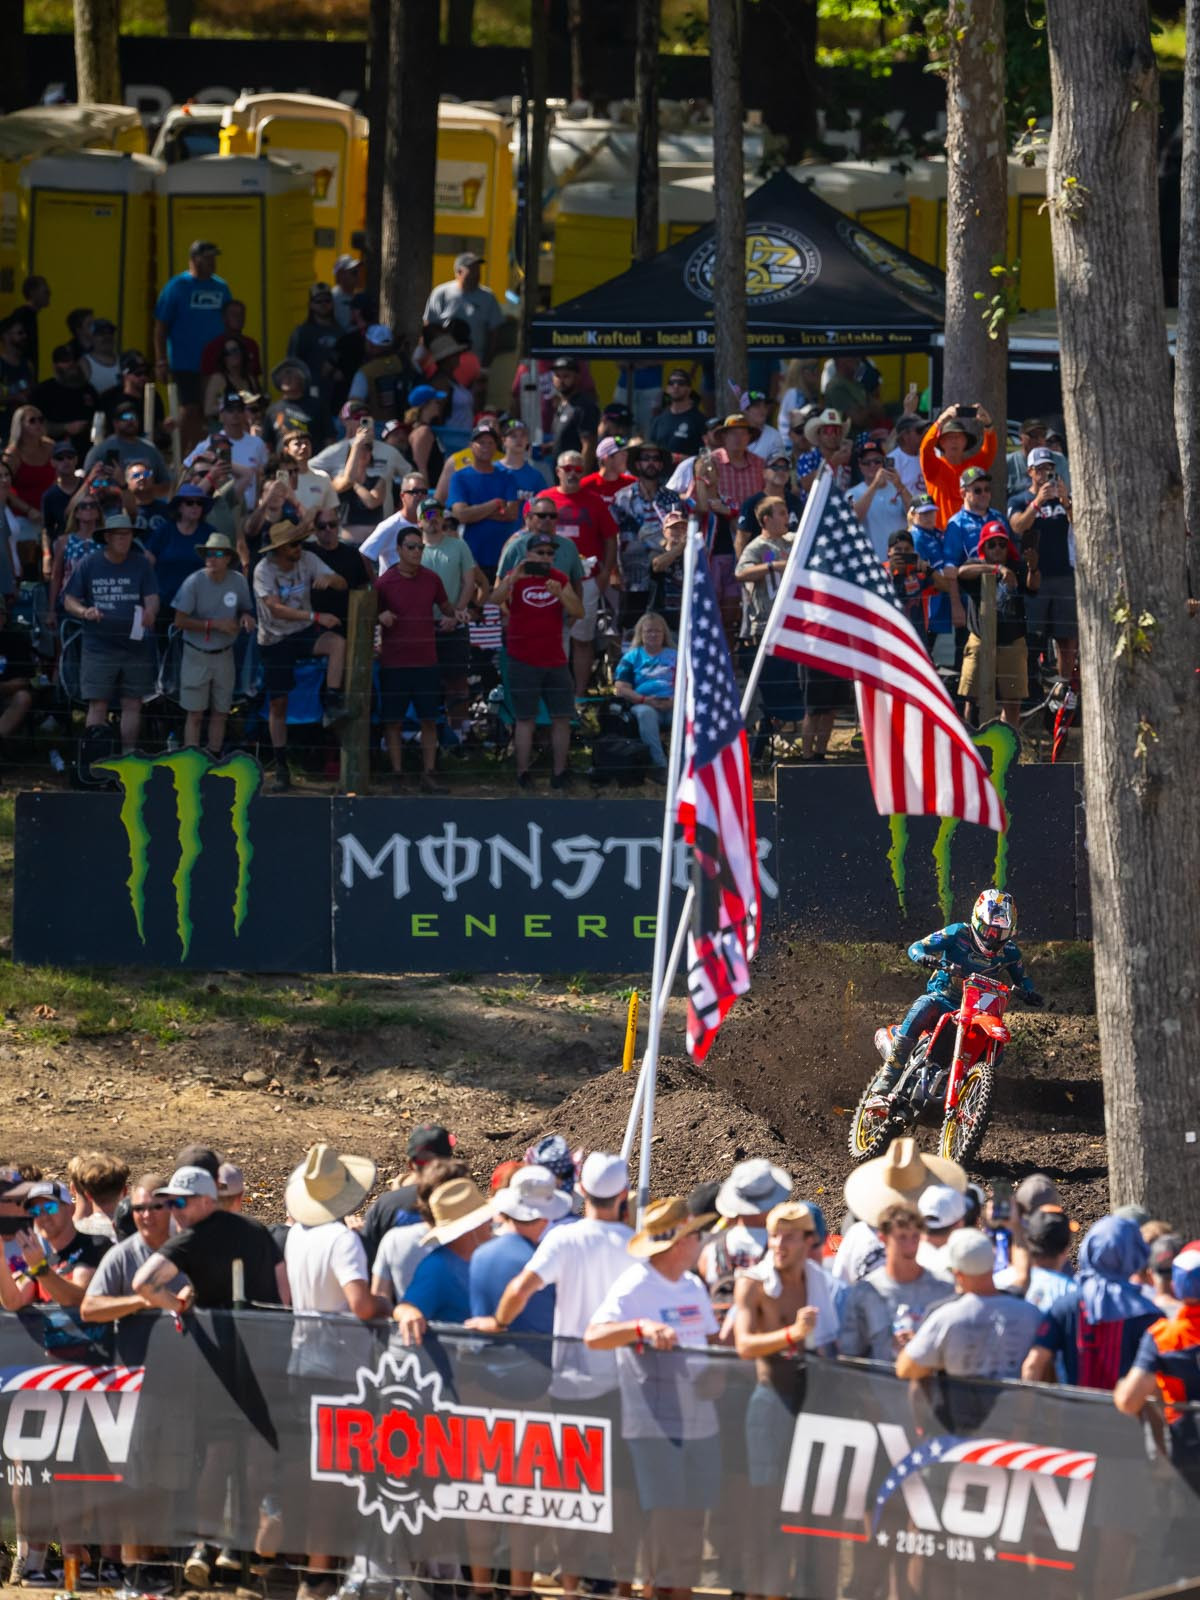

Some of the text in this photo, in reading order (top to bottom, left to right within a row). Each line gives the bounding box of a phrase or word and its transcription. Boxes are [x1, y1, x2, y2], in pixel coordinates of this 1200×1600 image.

[552, 331, 640, 345] handKrafted
[656, 330, 692, 345] local
[697, 330, 717, 345] Bo
[92, 577, 131, 586] HOLD ON
[411, 914, 657, 939] ENERG
[973, 993, 997, 1011] 1
[0, 1387, 141, 1463] ON
[316, 1406, 605, 1495] IRONMAN
[456, 1489, 605, 1524] RACEWAY
